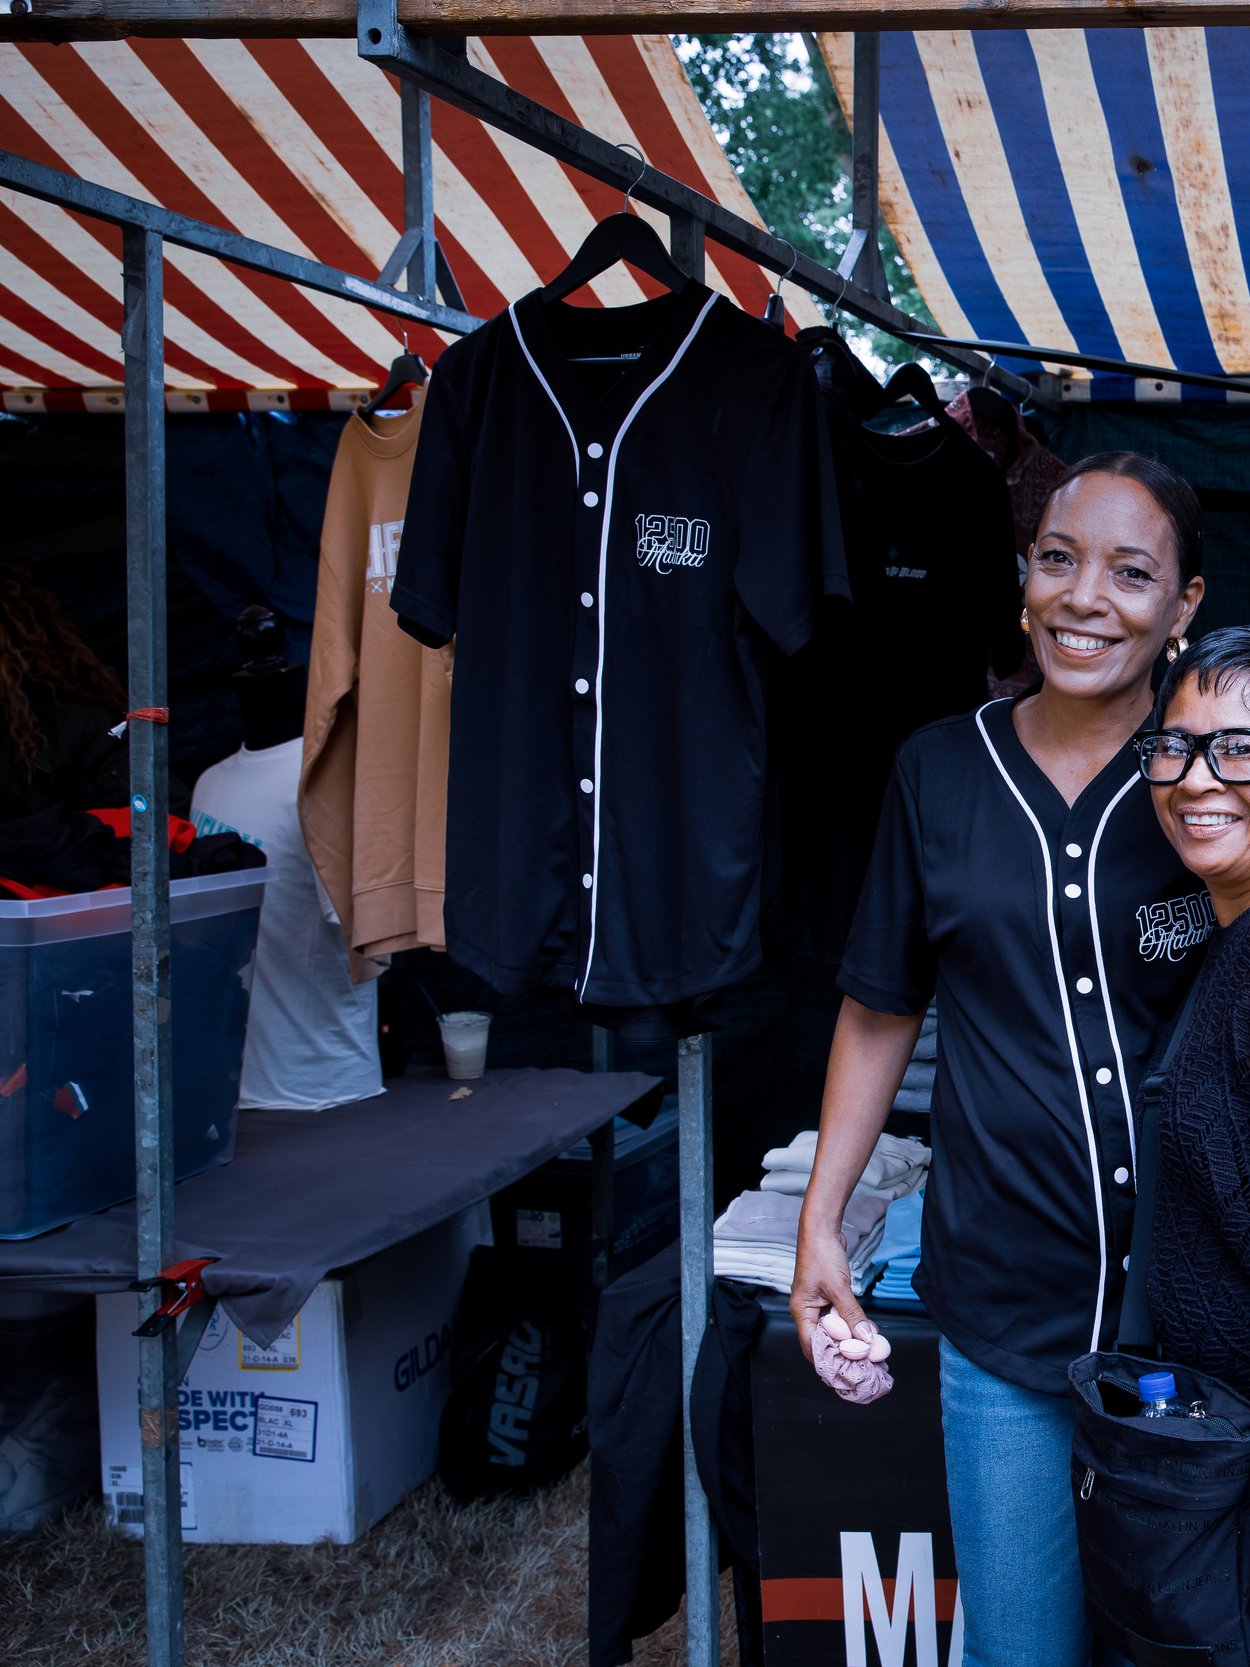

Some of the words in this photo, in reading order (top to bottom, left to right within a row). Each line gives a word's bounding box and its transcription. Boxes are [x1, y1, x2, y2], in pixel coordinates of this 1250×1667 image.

[1139, 927, 1214, 961] Maluk
[394, 1321, 455, 1391] GILDA
[840, 1531, 965, 1667] M
